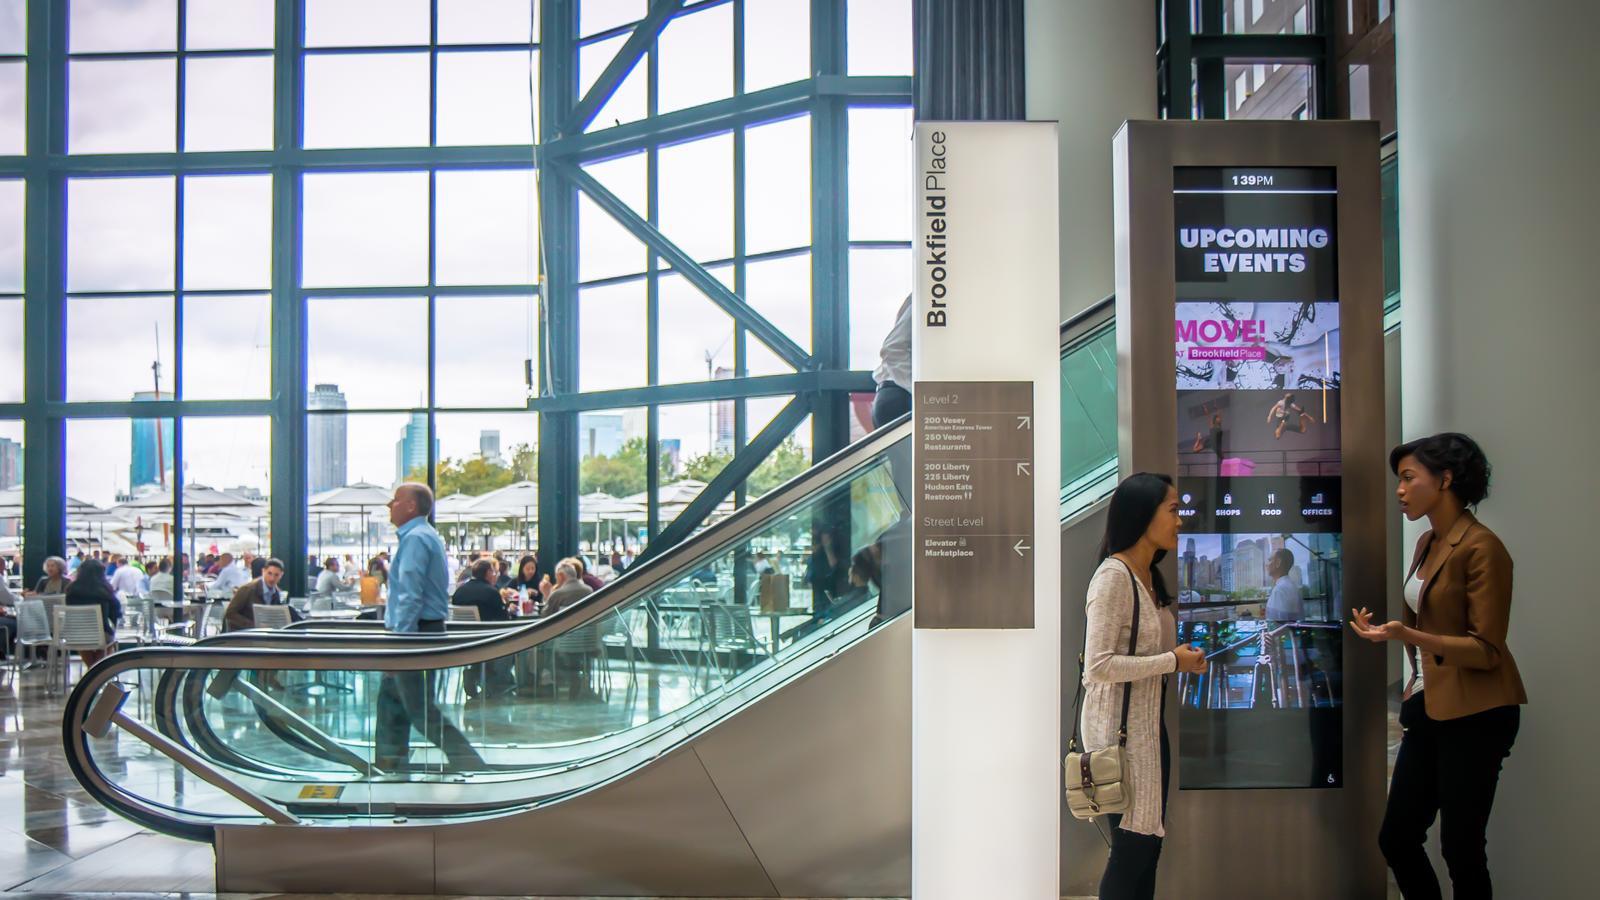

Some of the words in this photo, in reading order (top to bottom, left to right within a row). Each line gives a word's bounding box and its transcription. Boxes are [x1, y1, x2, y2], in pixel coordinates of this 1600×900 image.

[926, 131, 946, 191] Place
[1180, 228, 1328, 249] UPCOMING
[926, 196, 947, 328] Brookfield
[1204, 253, 1306, 273] EVENTS
[1175, 319, 1265, 343] MOVE!
[1191, 349, 1239, 358] Brookfield
[923, 394, 950, 405] Level
[951, 394, 959, 405] 2
[924, 416, 941, 424] 200
[942, 416, 966, 425] Vesey
[924, 433, 942, 441] 250
[942, 433, 966, 441] Vesey
[924, 443, 972, 451] Restaurants
[924, 463, 941, 471] 200
[942, 463, 970, 471] Liberty
[924, 473, 941, 481] 225
[942, 473, 970, 481] Liberty
[924, 483, 955, 491] Hudson
[956, 483, 973, 491] Eats
[924, 493, 963, 501] Restroom
[1302, 508, 1333, 516] OFFICES
[924, 516, 954, 527] Street
[957, 516, 984, 527] Level
[925, 539, 957, 547] Elevator
[925, 549, 974, 557] Marketplace
